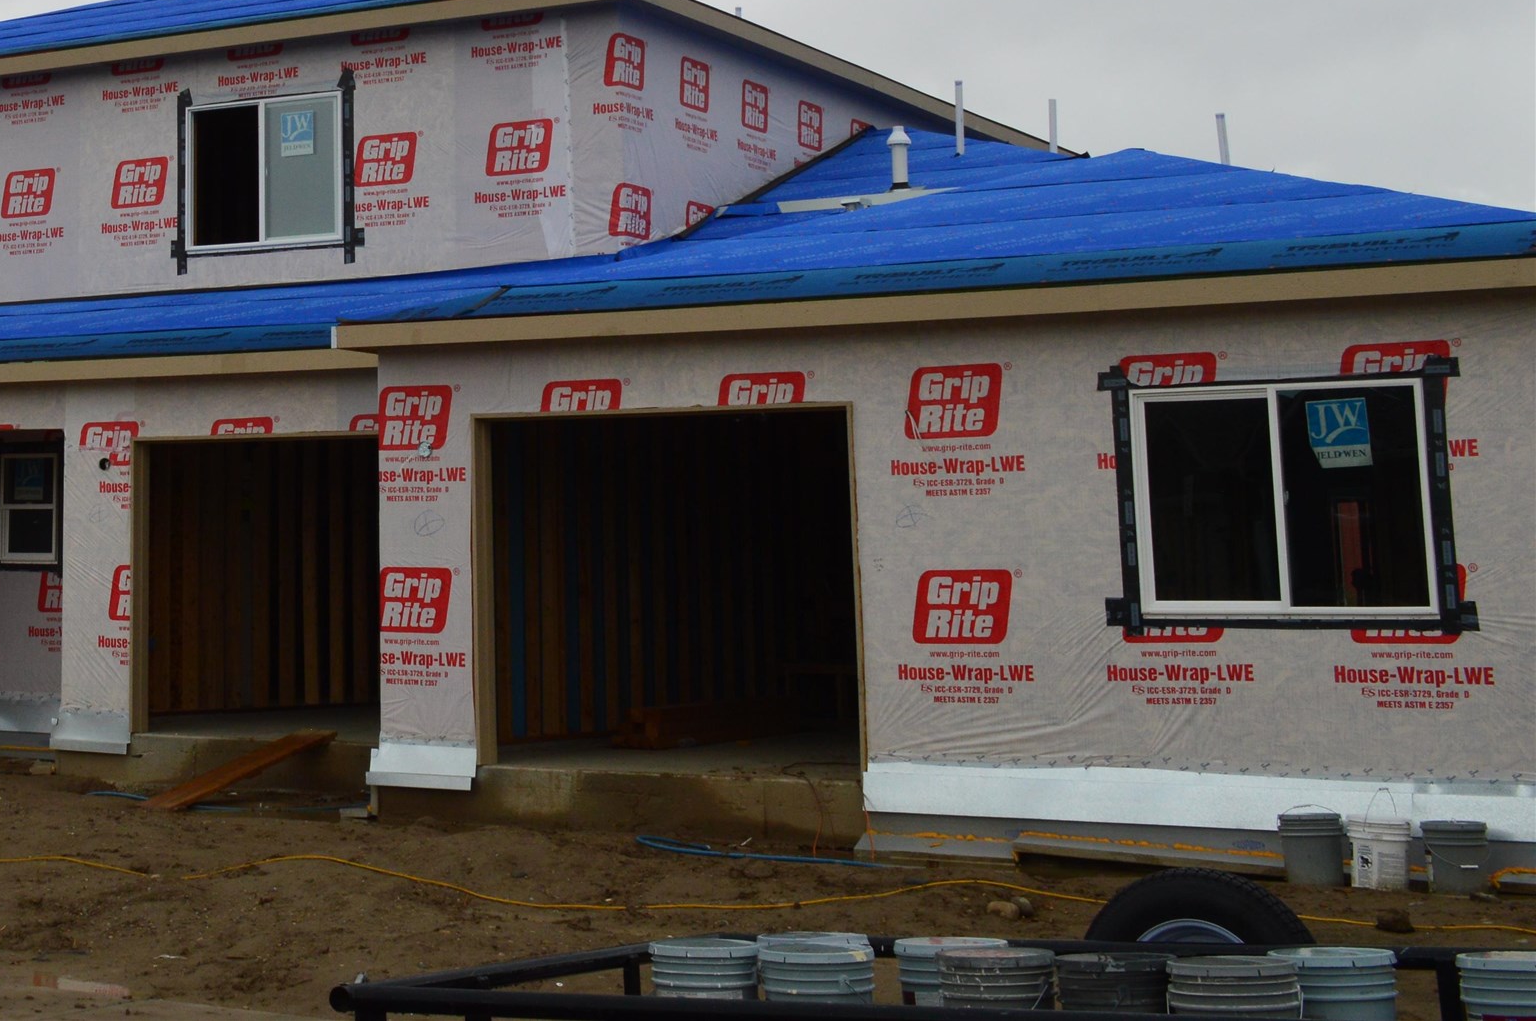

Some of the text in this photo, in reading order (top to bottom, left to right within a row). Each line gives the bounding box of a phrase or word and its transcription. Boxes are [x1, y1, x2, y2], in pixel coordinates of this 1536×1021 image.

[471, 36, 562, 58] House-Wrap-LWE
[615, 37, 641, 66] Grip
[218, 67, 299, 87] House-Wrap-LWE
[613, 63, 640, 87] Rite
[685, 61, 707, 86] Grip
[102, 82, 179, 101] House-Wrap-LWE
[683, 84, 705, 108] Rite
[745, 84, 765, 107] Grip
[593, 102, 654, 122] House-Wrap-LWE
[744, 106, 764, 128] Rite
[802, 104, 820, 125] Grip
[281, 113, 311, 140] JW
[496, 122, 545, 148] Grip
[675, 118, 718, 142] House-Wrap-LWE
[801, 125, 819, 147] Rite
[363, 138, 410, 161] Grip
[737, 139, 776, 161] House-Wrap-LWE
[361, 161, 405, 183] Rite
[494, 150, 541, 172] Rite
[10, 174, 48, 195] Grip
[121, 163, 161, 184] Grip
[8, 196, 45, 215] Rite
[118, 185, 156, 205] Rite
[475, 185, 566, 204] House-Wrap-LWE
[620, 187, 647, 216] Grip
[618, 213, 646, 237] Rite
[728, 379, 794, 405] Grip
[919, 371, 990, 402] Grip
[385, 392, 442, 420] Grip
[919, 405, 985, 433] Rite
[1311, 402, 1362, 439] JW
[383, 421, 436, 445] Rite
[922, 443, 991, 453] www.grip-rite.com
[891, 455, 1025, 476] House-Wrap-LWE
[926, 489, 947, 497] MEETS
[976, 478, 995, 486] Grade
[384, 573, 442, 603] Grip
[927, 576, 999, 610] Grip
[381, 602, 436, 628] Rite
[925, 609, 994, 638] Rite
[1140, 649, 1217, 658] www.grip-rite.com
[1371, 651, 1453, 660] www.grip-rite.com
[898, 664, 1034, 684] House-Wrap-LWE
[1107, 664, 1254, 684] House-Wrap-LWE
[1334, 665, 1494, 688] House-Wrap-LWE
[983, 696, 999, 704] 2357
[985, 686, 1004, 694] Grade
[1146, 697, 1217, 705] MEETS ASTM E 2357
[1201, 686, 1222, 695] Grade
[1226, 686, 1231, 695] D
[1436, 690, 1459, 698] Grade
[1376, 700, 1454, 710] MEETS ASTM E 2357
